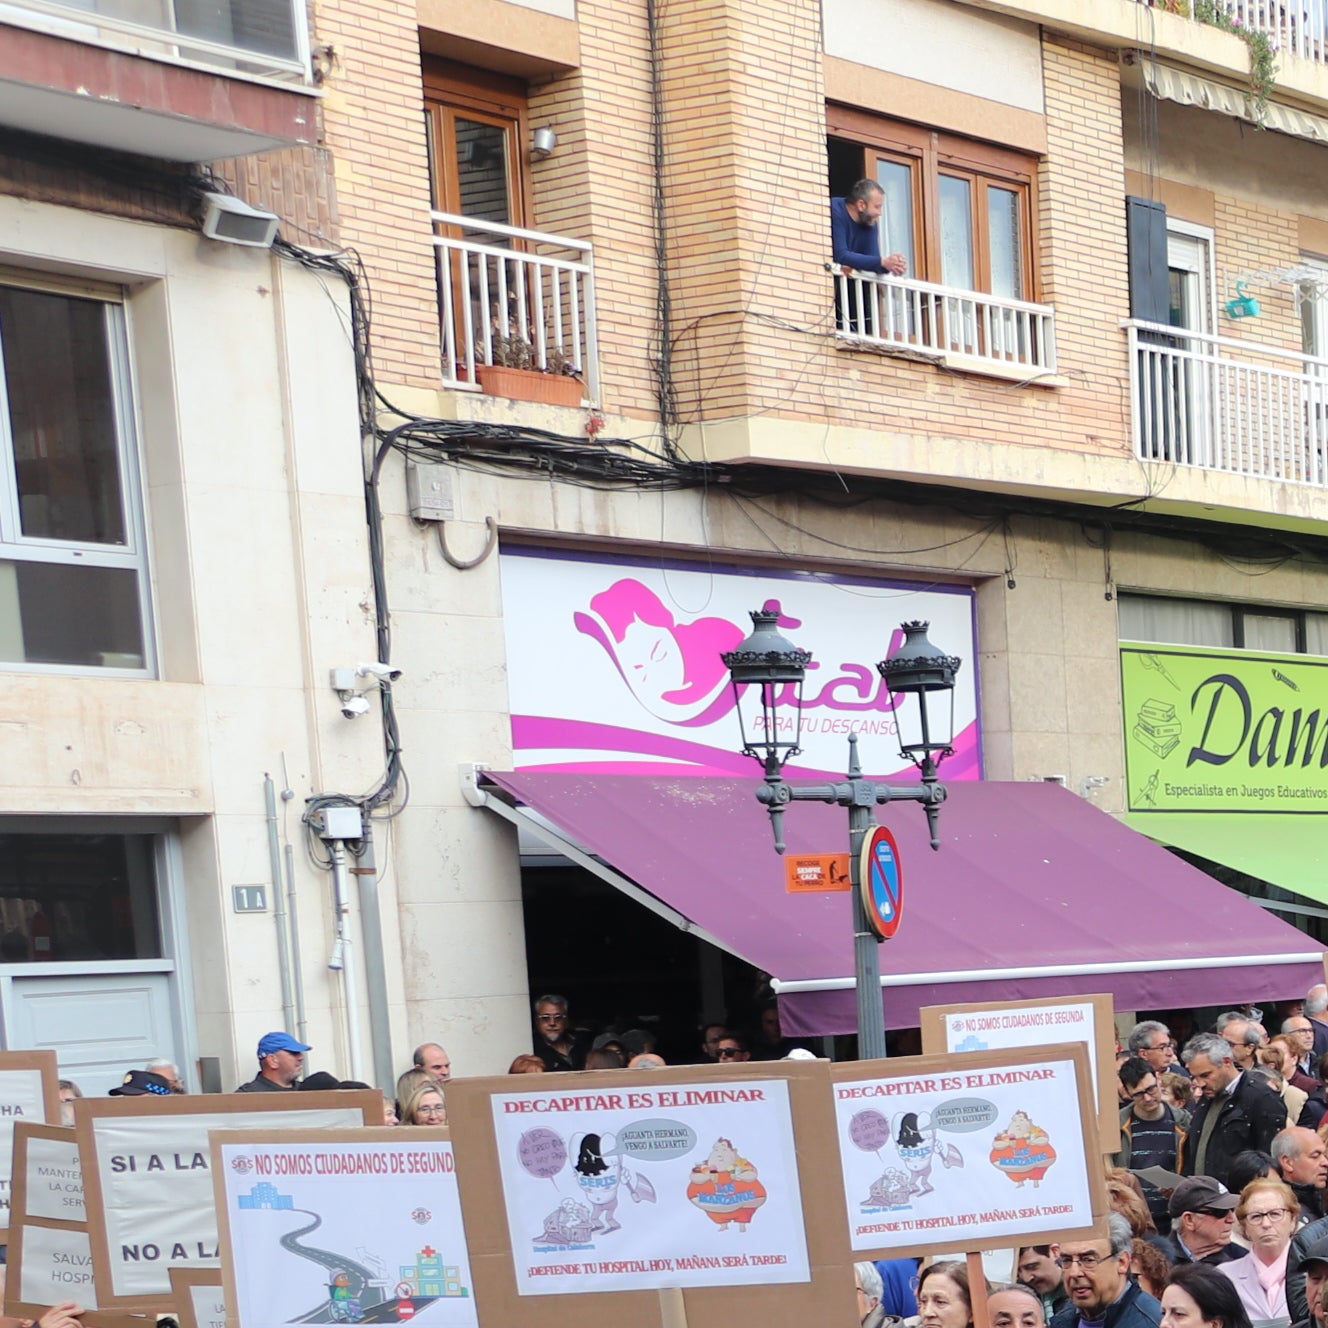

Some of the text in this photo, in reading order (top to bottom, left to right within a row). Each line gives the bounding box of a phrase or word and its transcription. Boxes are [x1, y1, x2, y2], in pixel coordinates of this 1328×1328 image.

[753, 715, 898, 736] PARA TU DESCANSO
[1165, 783, 1225, 797] Especialista
[1226, 786, 1238, 796] en
[1240, 785, 1276, 800] Juegos
[1277, 785, 1328, 799] Educativos
[965, 1010, 1085, 1031] NO SOMOS CIUDADANOS DE SEGUNDA
[838, 1069, 1055, 1100] DECAPITAR ES ELIMINAR
[504, 1088, 766, 1114] DECAPITAR ES ELIMINAR
[900, 1145, 932, 1157] SERIS
[111, 1152, 209, 1172] SI A LA
[255, 1152, 455, 1176] NO SOMOS CIUDADANOS DE SEGUND
[49, 1183, 62, 1193] LA
[579, 1174, 617, 1188] SERIS
[856, 1204, 1073, 1236] ¡DEFIENDE TU HOSPITAL HOY, MAÑANA SERÁ TARDE!
[122, 1243, 188, 1262] NO A
[528, 1253, 787, 1279] ¡DEFIENDE TU HOSPITAL HOY, MAÑANA SERÁ TARDE!
